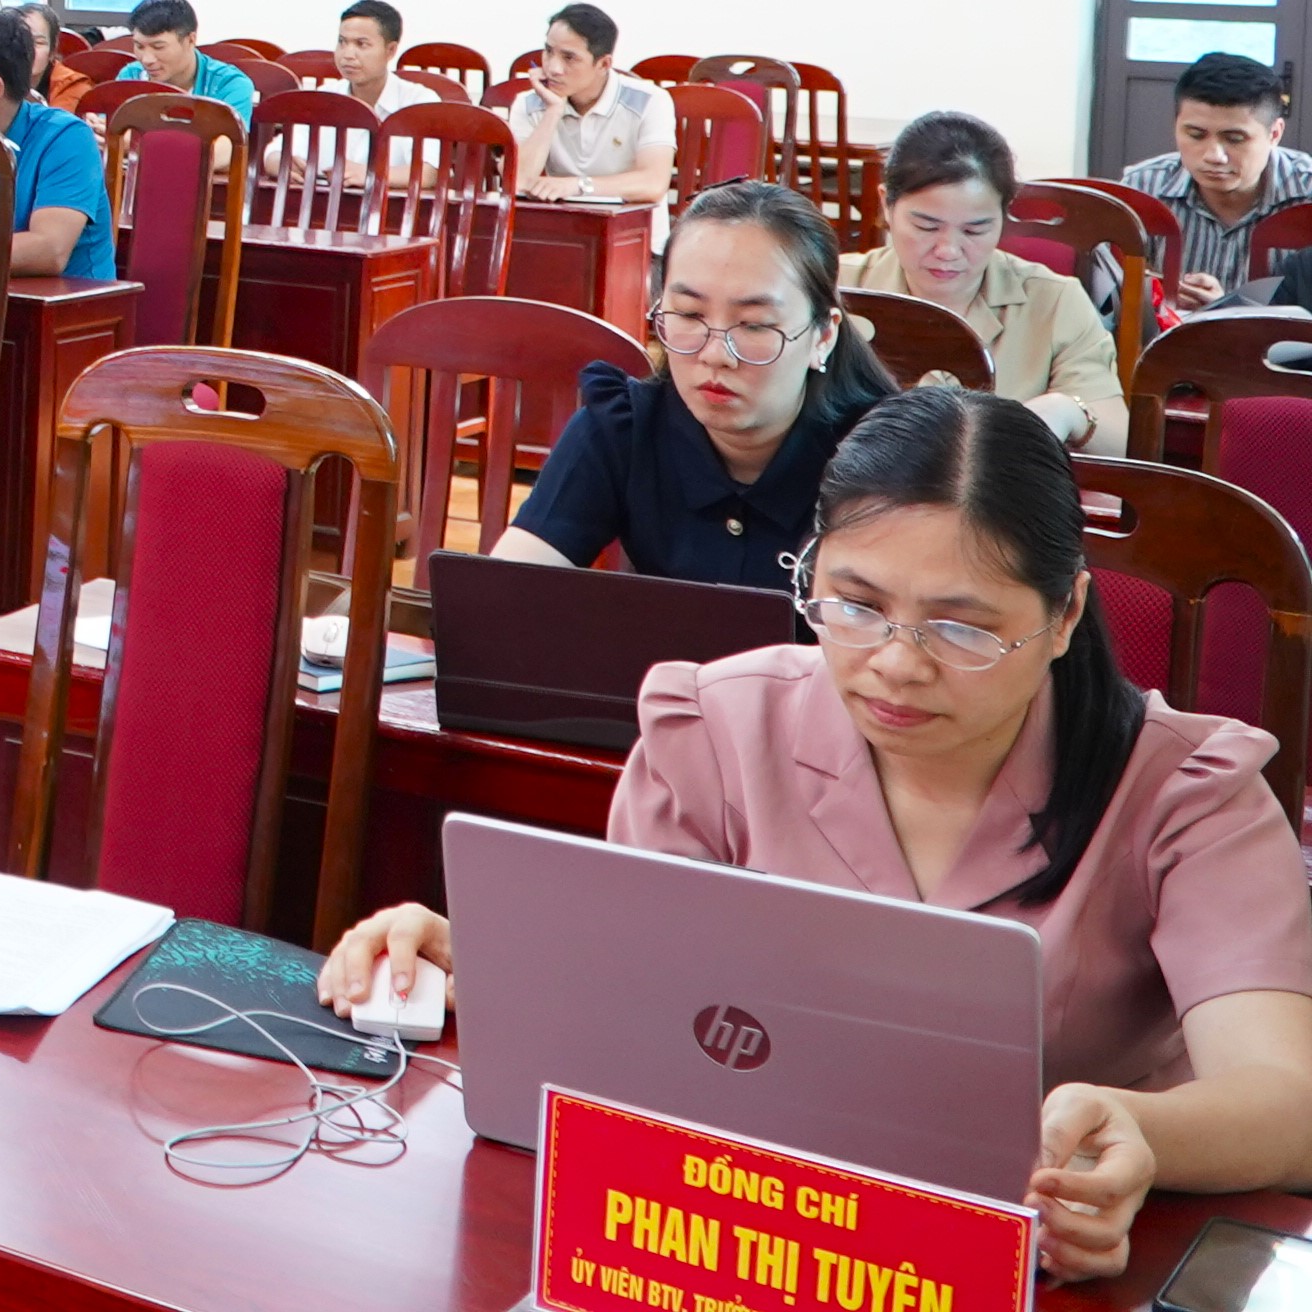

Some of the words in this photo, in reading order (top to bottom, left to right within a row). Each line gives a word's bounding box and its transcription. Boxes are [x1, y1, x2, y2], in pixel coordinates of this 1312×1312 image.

[703, 1004, 763, 1068] hp
[682, 1153, 785, 1211] ĐỒNG
[796, 1186, 859, 1231] CHÍ
[571, 1247, 597, 1287] ỦY
[600, 1265, 644, 1303] VIÊN
[604, 1188, 721, 1273] PHAN
[733, 1225, 800, 1307] THỊ
[813, 1247, 954, 1312] TUYÊN
